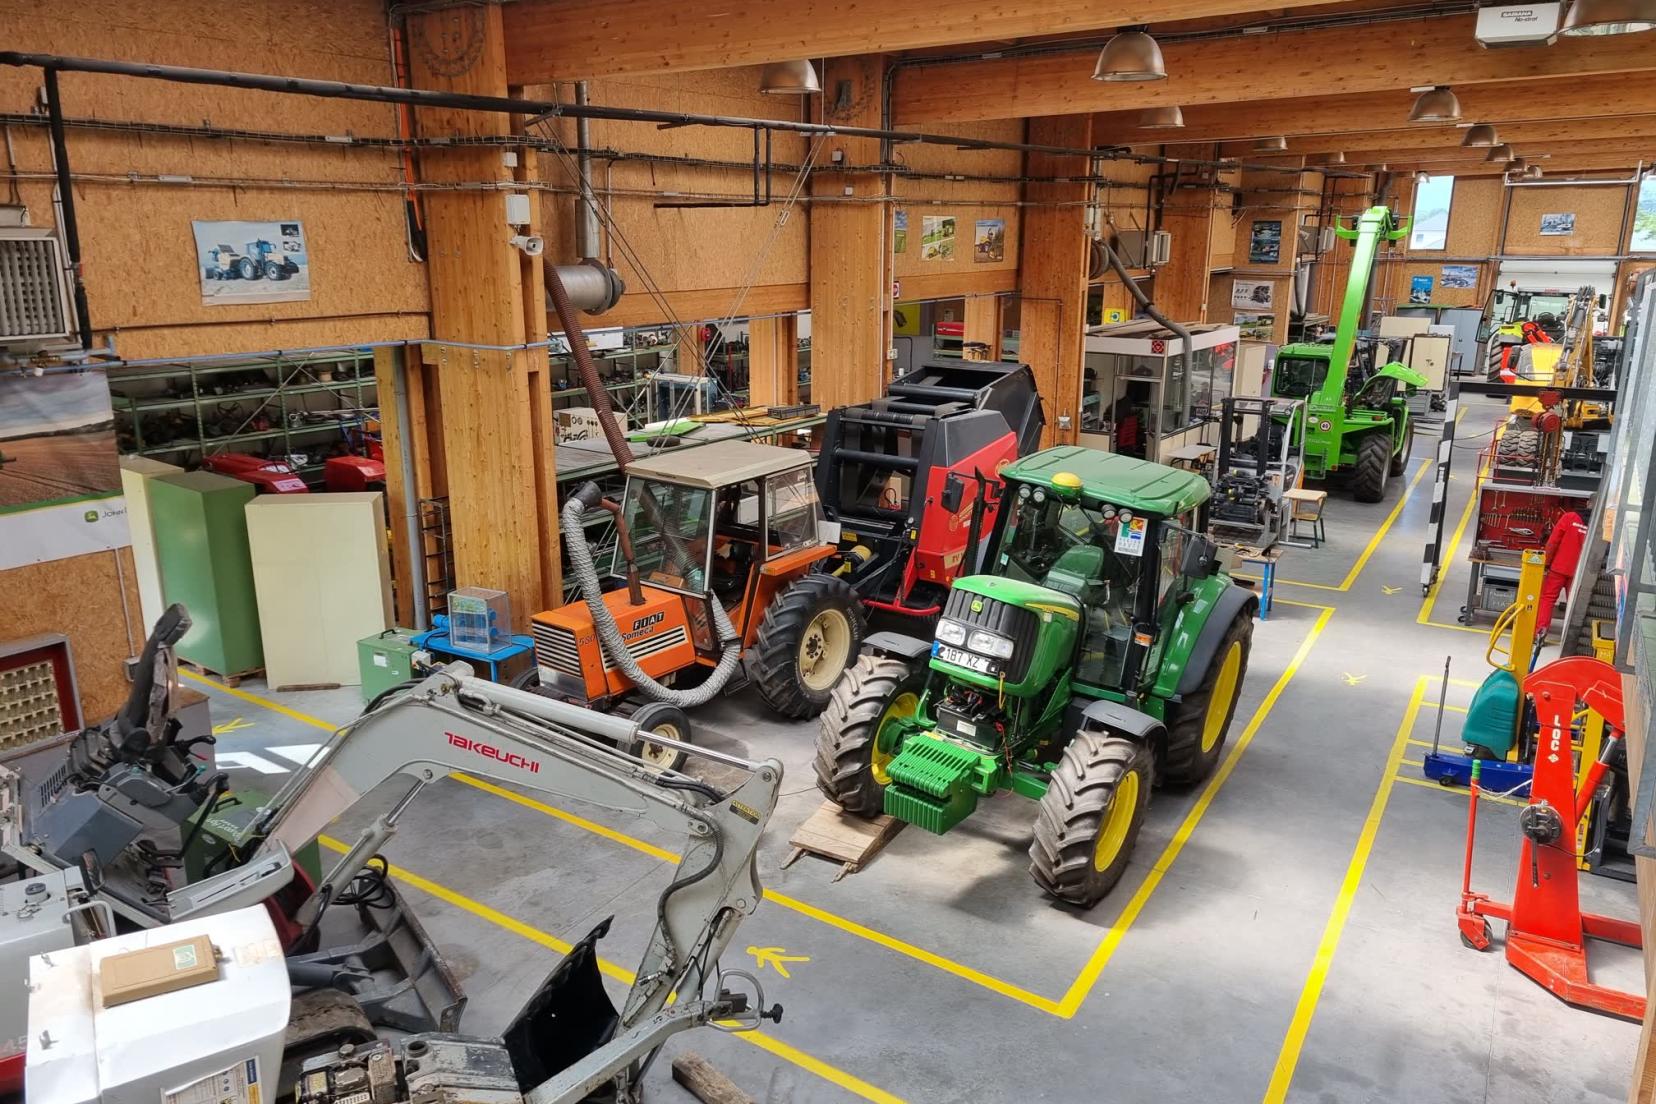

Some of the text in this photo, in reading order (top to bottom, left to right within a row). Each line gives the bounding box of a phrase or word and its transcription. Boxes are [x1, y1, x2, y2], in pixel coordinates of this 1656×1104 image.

[633, 612, 664, 631] FIAT
[621, 627, 654, 641] Someca
[967, 653, 980, 668] XZ
[444, 732, 540, 774] TAKEUCHI
